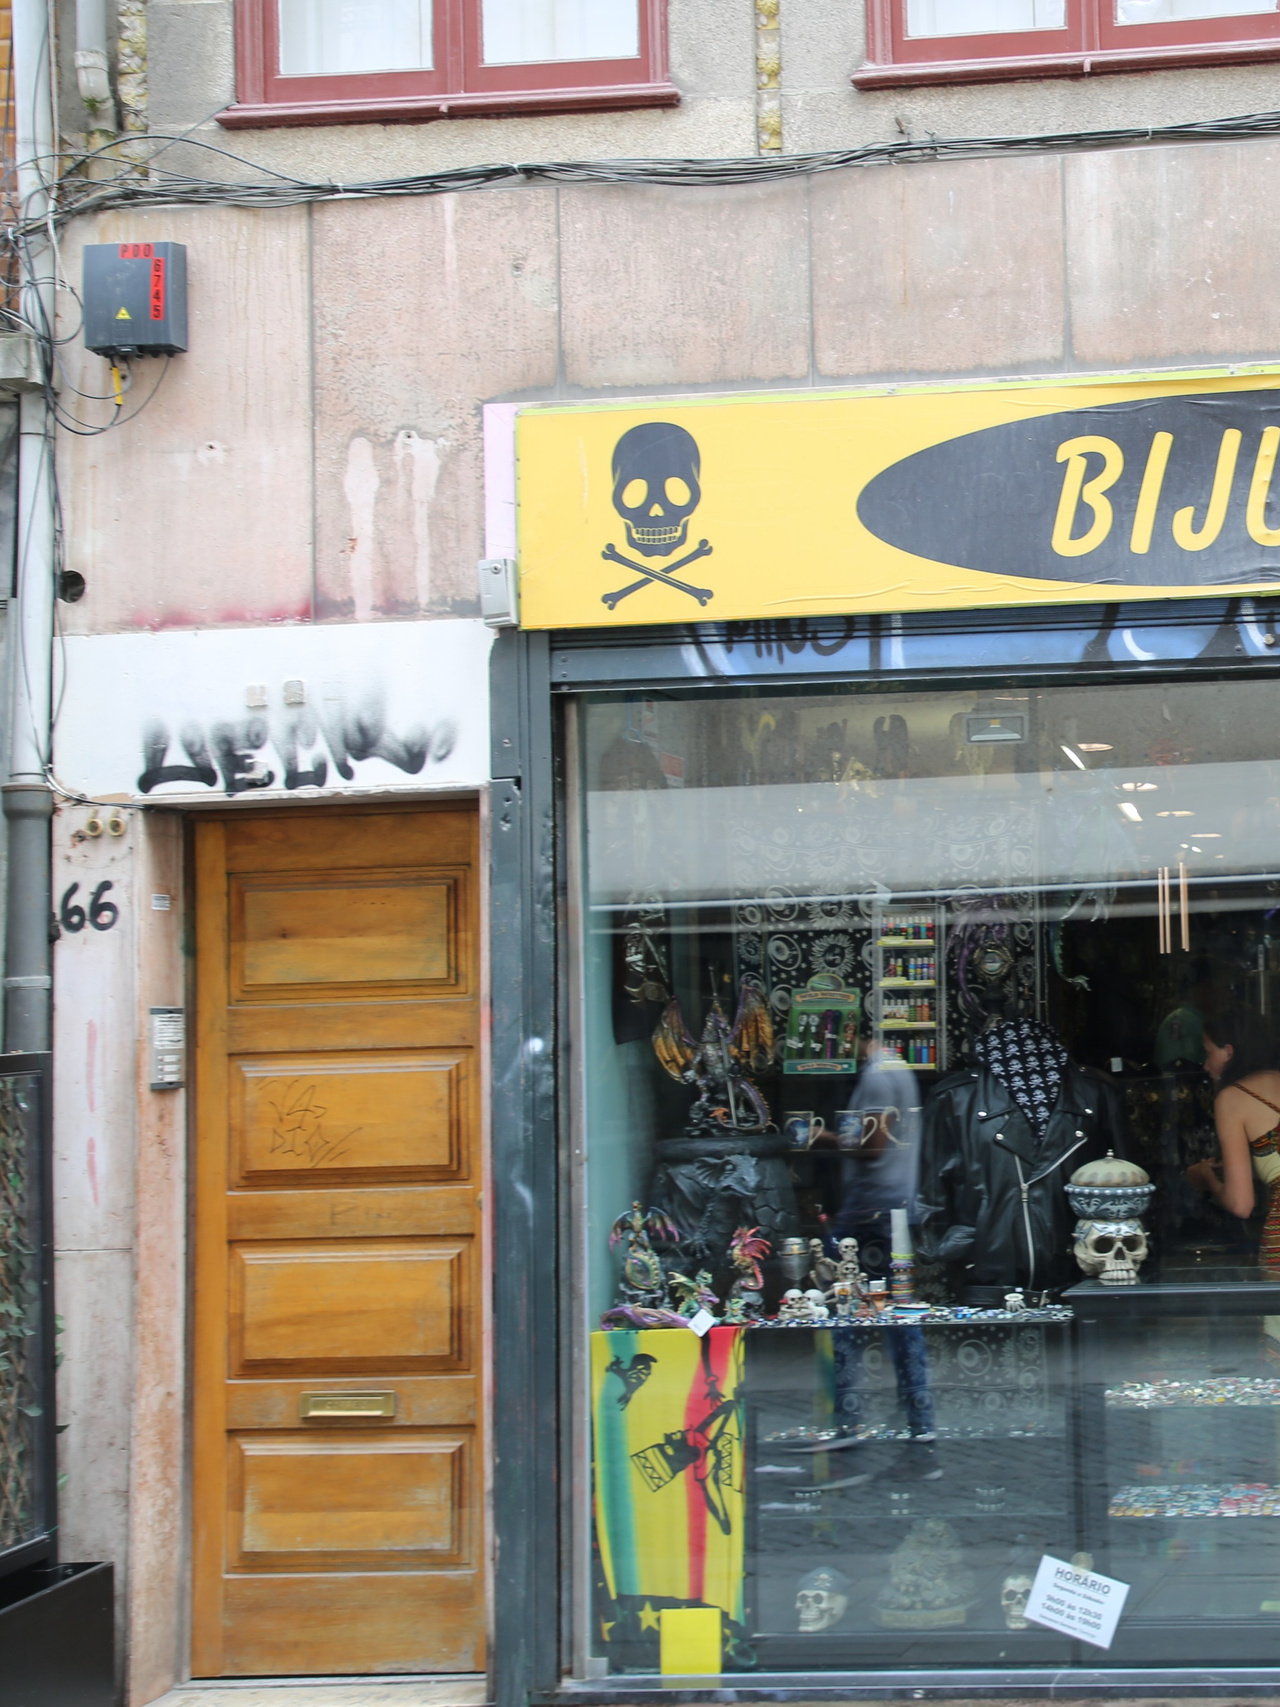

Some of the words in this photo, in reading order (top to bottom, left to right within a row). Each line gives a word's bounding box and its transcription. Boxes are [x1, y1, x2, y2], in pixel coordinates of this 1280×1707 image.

[87, 808, 126, 837] 66
[61, 880, 118, 934] 66
[1055, 1567, 1111, 1595] HORÁRIO
